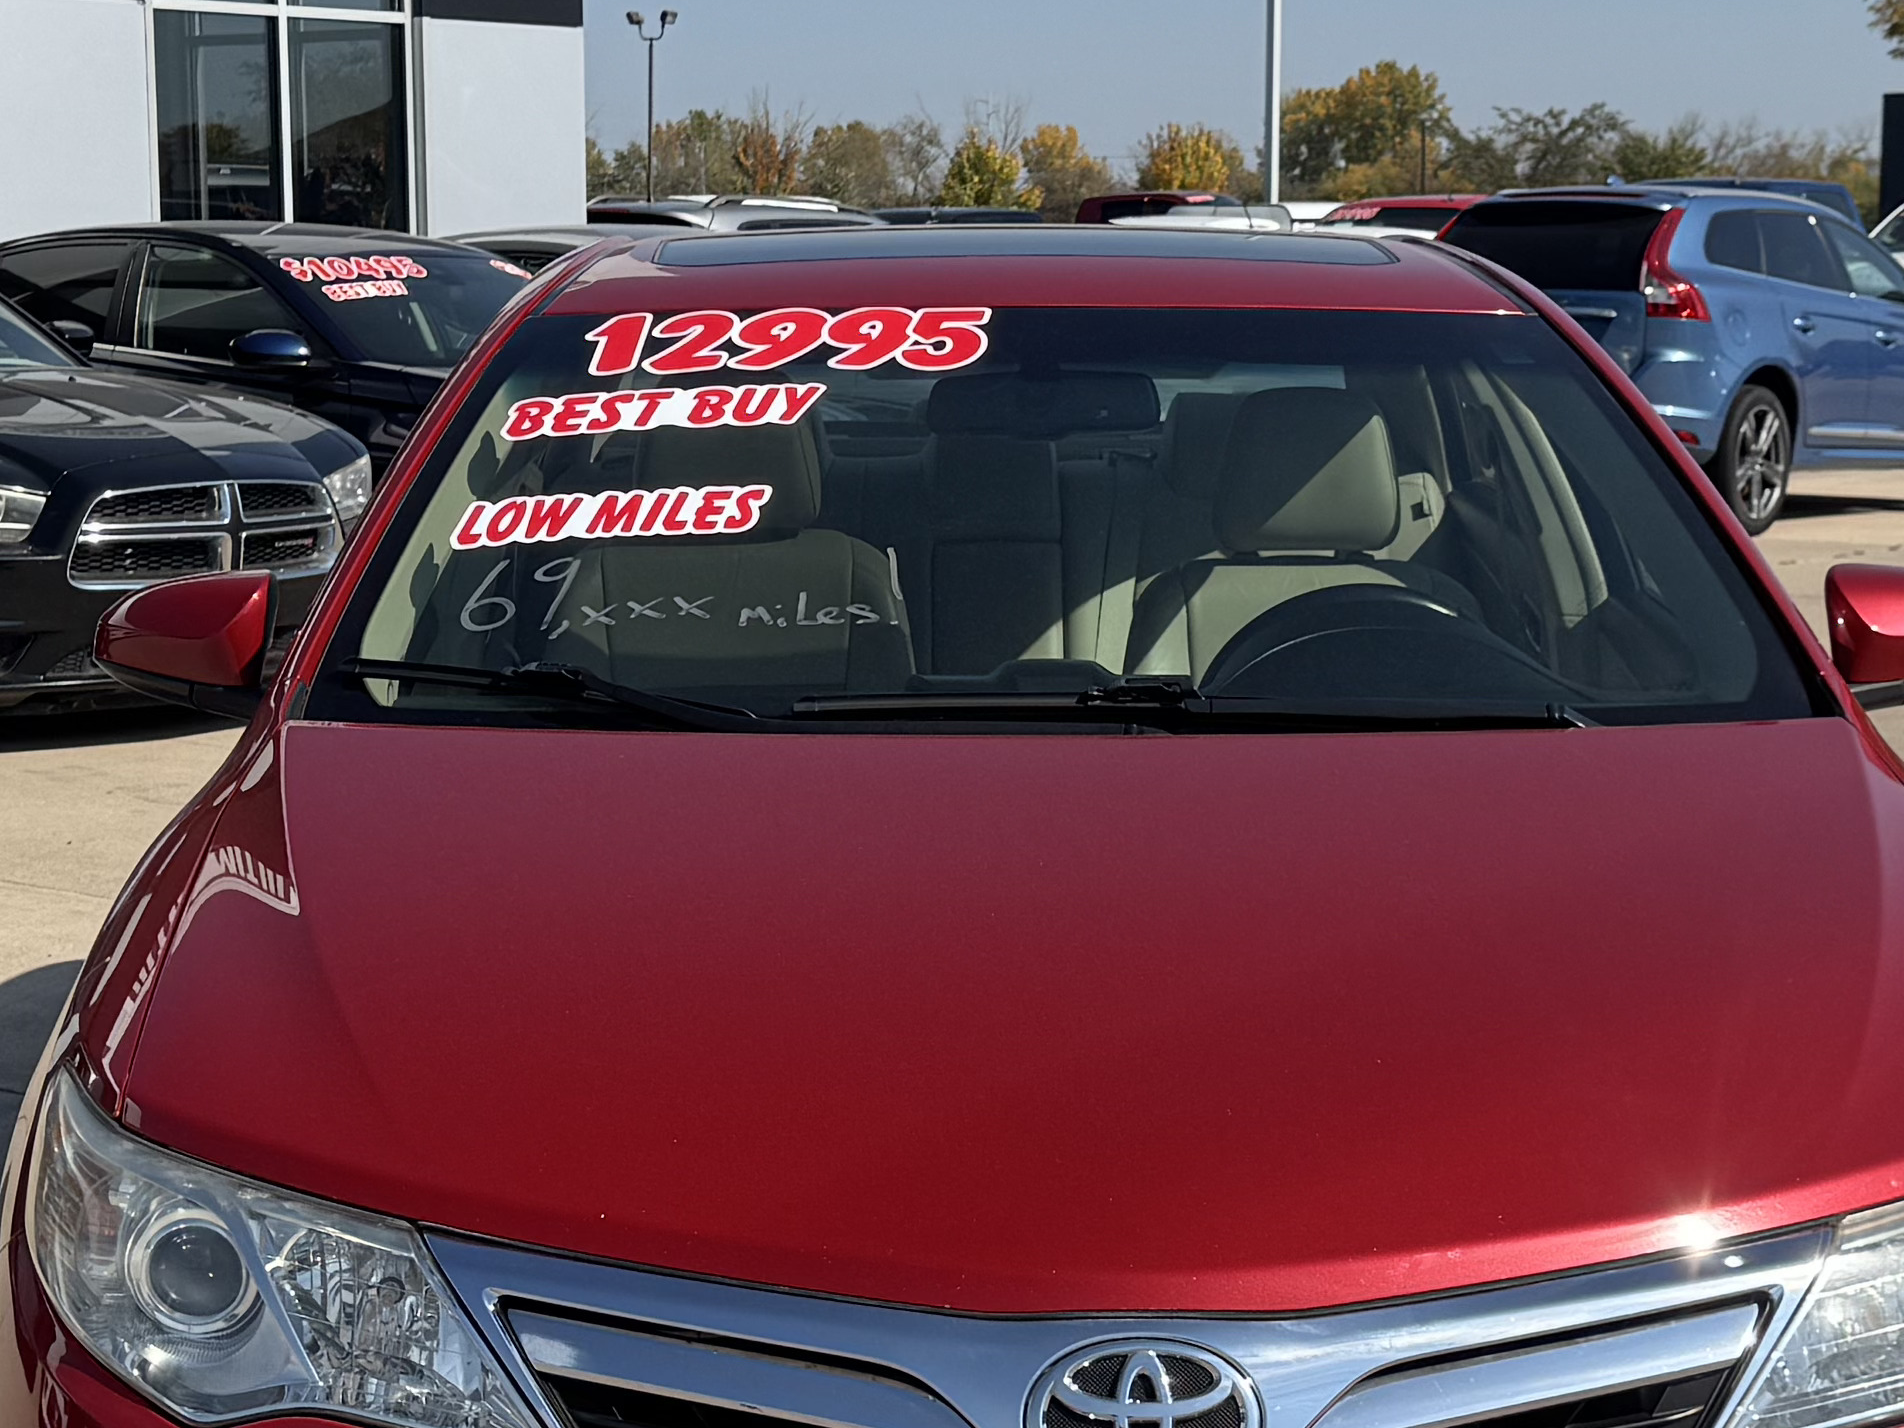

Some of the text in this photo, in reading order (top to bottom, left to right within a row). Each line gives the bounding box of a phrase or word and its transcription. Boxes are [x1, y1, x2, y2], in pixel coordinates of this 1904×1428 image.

[280, 255, 428, 282] $10495
[585, 307, 992, 376] 12995
[506, 383, 821, 437] BEST BUY
[454, 483, 768, 547] LOW MILES
